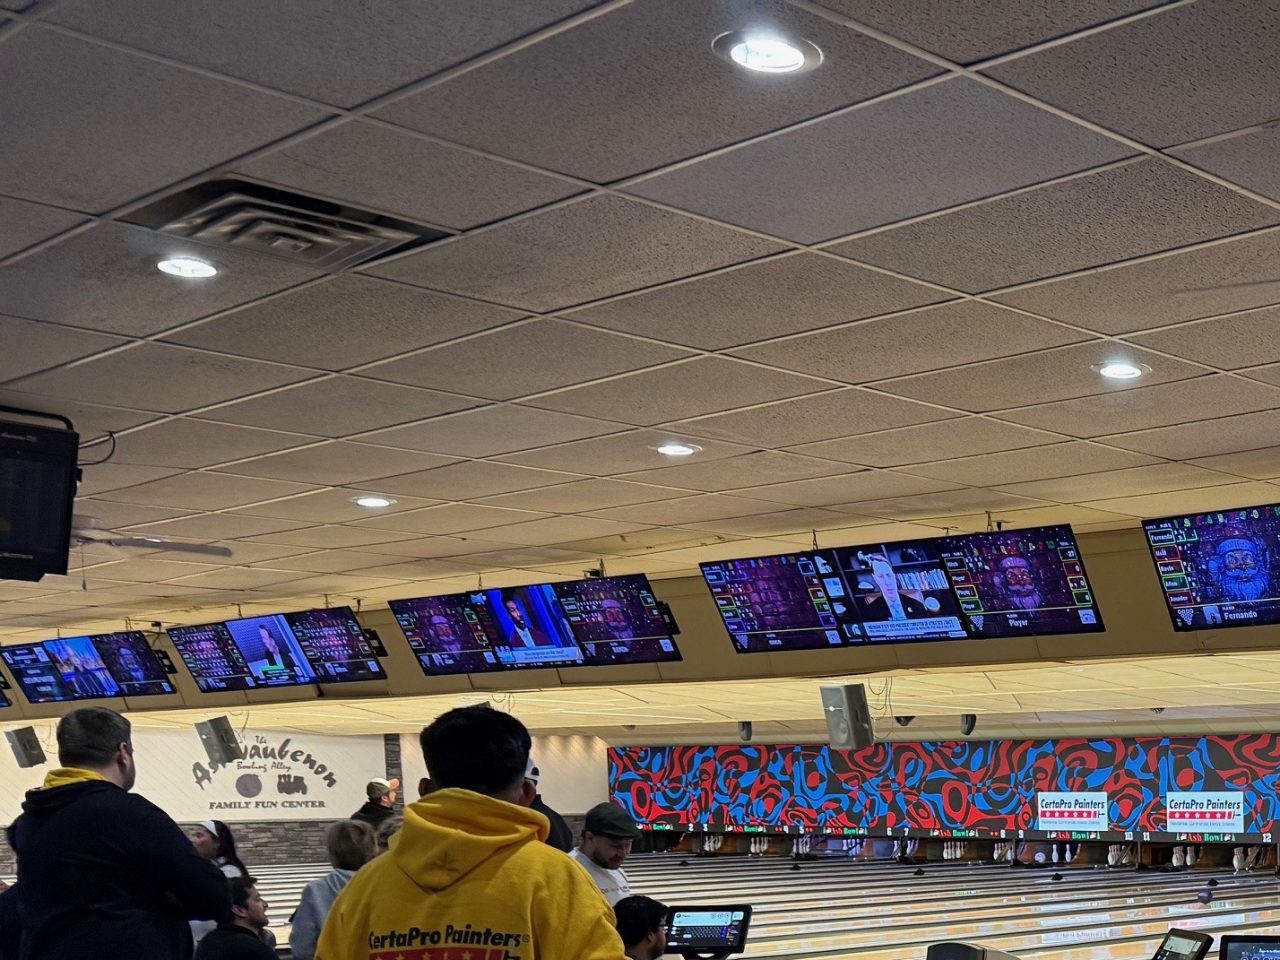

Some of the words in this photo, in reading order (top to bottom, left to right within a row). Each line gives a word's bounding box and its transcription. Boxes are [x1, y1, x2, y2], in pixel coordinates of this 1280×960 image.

[1223, 610, 1258, 620] Fernando
[1008, 618, 1029, 628] Player
[254, 735, 267, 745] The
[236, 761, 268, 773] Bowling
[270, 761, 292, 772] Alley
[209, 801, 251, 810] FAMILY
[254, 801, 279, 809] FUN
[281, 800, 326, 809] CENTER
[1040, 799, 1073, 810] CertaPro
[1073, 798, 1106, 810] Painters
[1169, 798, 1207, 810] CertaPro
[1206, 798, 1241, 810] Painters
[1056, 832, 1070, 840] Ash
[1071, 831, 1090, 840] Bowl
[1124, 831, 1134, 841] 10
[1143, 832, 1151, 841] 11
[1186, 833, 1203, 842] Ash
[1203, 833, 1224, 842] Bowl
[1262, 833, 1272, 843] 12
[368, 926, 442, 950] CertaPro
